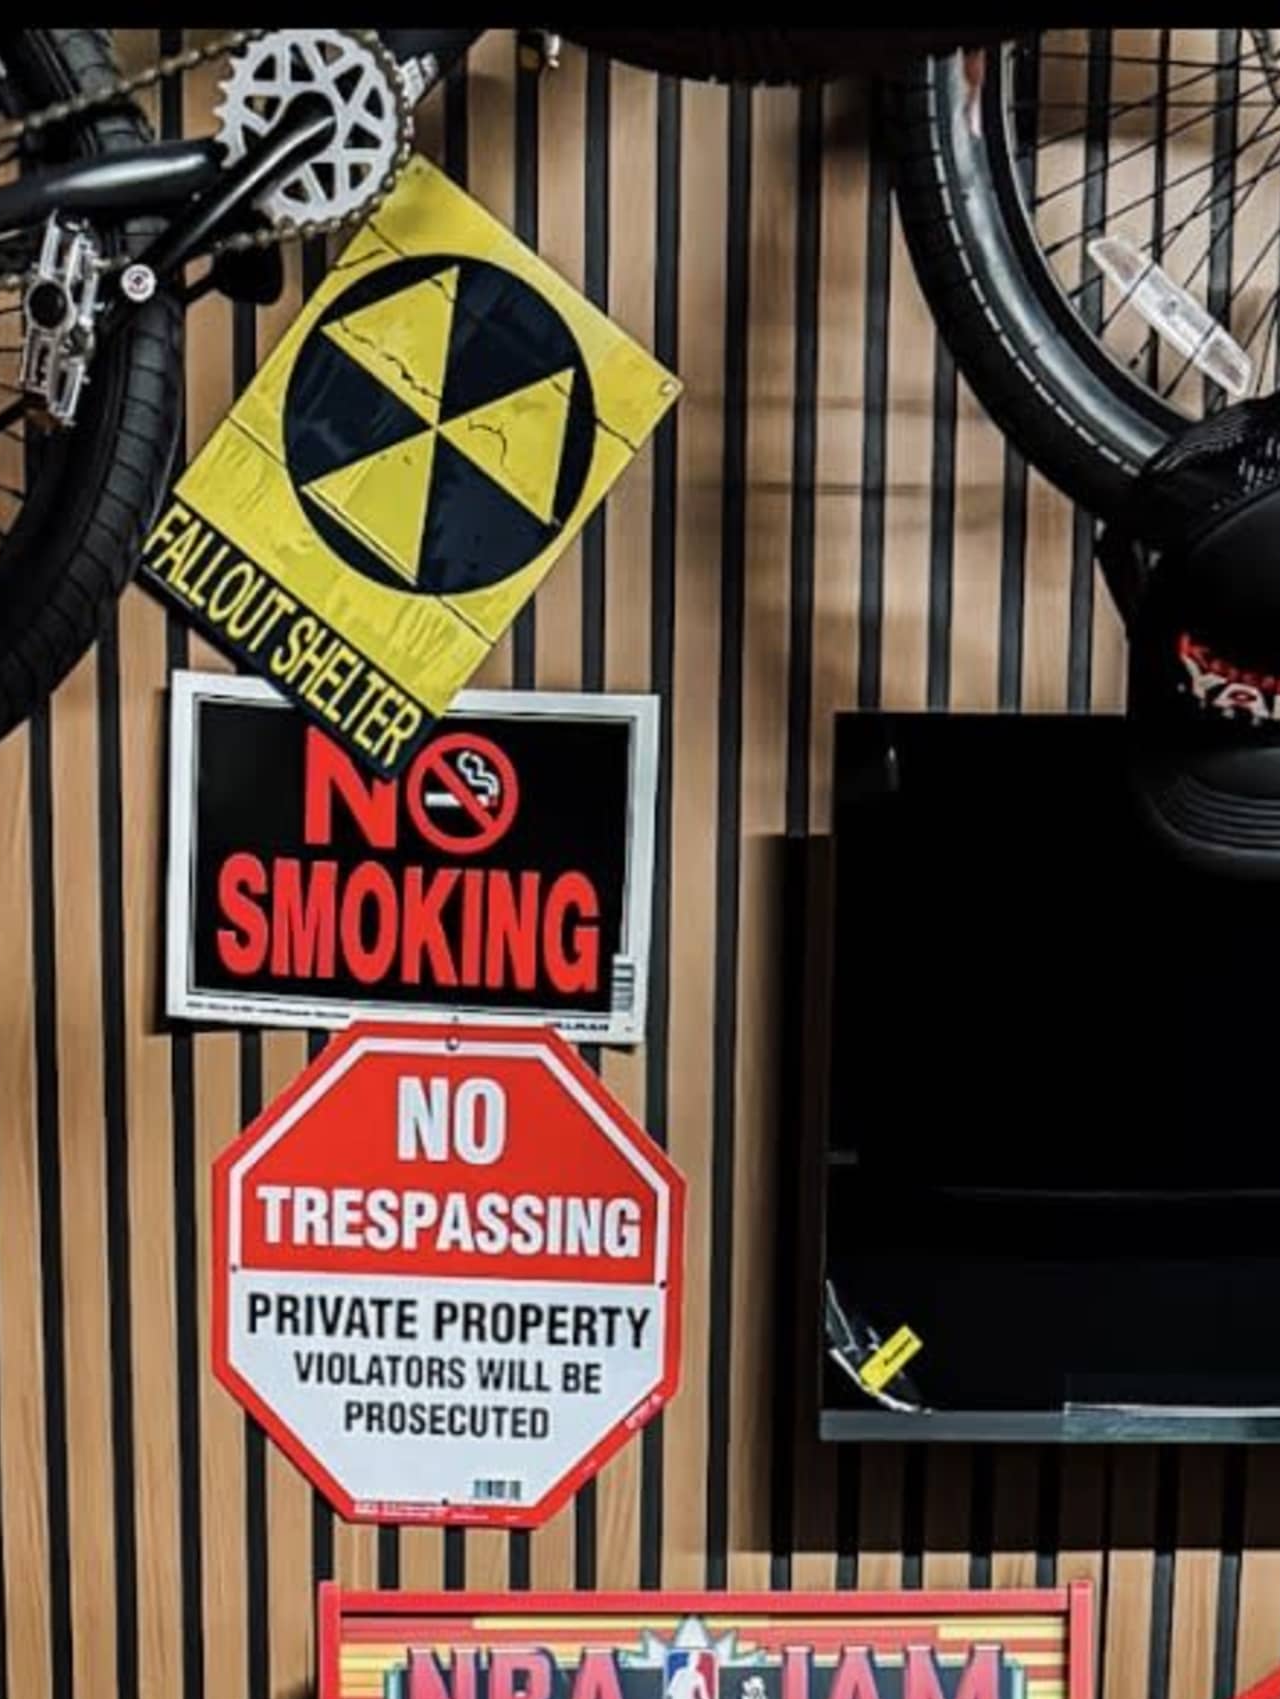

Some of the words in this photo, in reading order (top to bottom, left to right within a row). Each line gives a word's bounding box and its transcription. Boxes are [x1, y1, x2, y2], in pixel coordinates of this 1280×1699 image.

[142, 505, 294, 651] FALLOUT
[270, 610, 421, 768] SHELTER
[217, 852, 599, 994] SMOKING
[397, 1076, 506, 1165] NO
[256, 1184, 642, 1259] TRESPASSING
[247, 1293, 418, 1339] PRIVATE
[433, 1301, 650, 1349] PROPERTY
[294, 1351, 467, 1389] VIOLATORS
[476, 1359, 552, 1393] WILL
[563, 1363, 602, 1395] BE
[344, 1401, 550, 1439] PROSECUTED
